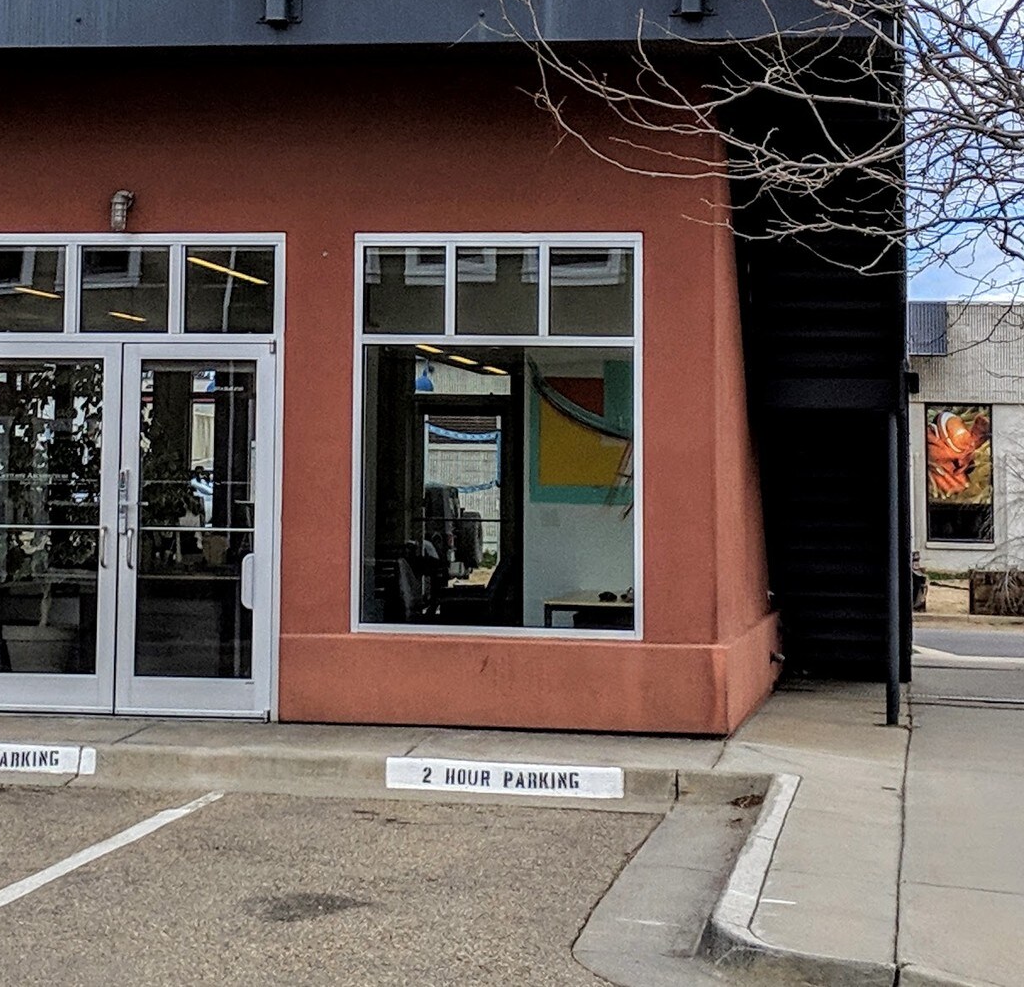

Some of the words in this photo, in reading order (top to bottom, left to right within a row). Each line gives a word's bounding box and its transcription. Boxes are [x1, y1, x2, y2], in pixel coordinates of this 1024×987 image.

[422, 767, 432, 784] 2
[445, 768, 491, 787] HOUR
[503, 771, 580, 789] PARKING
